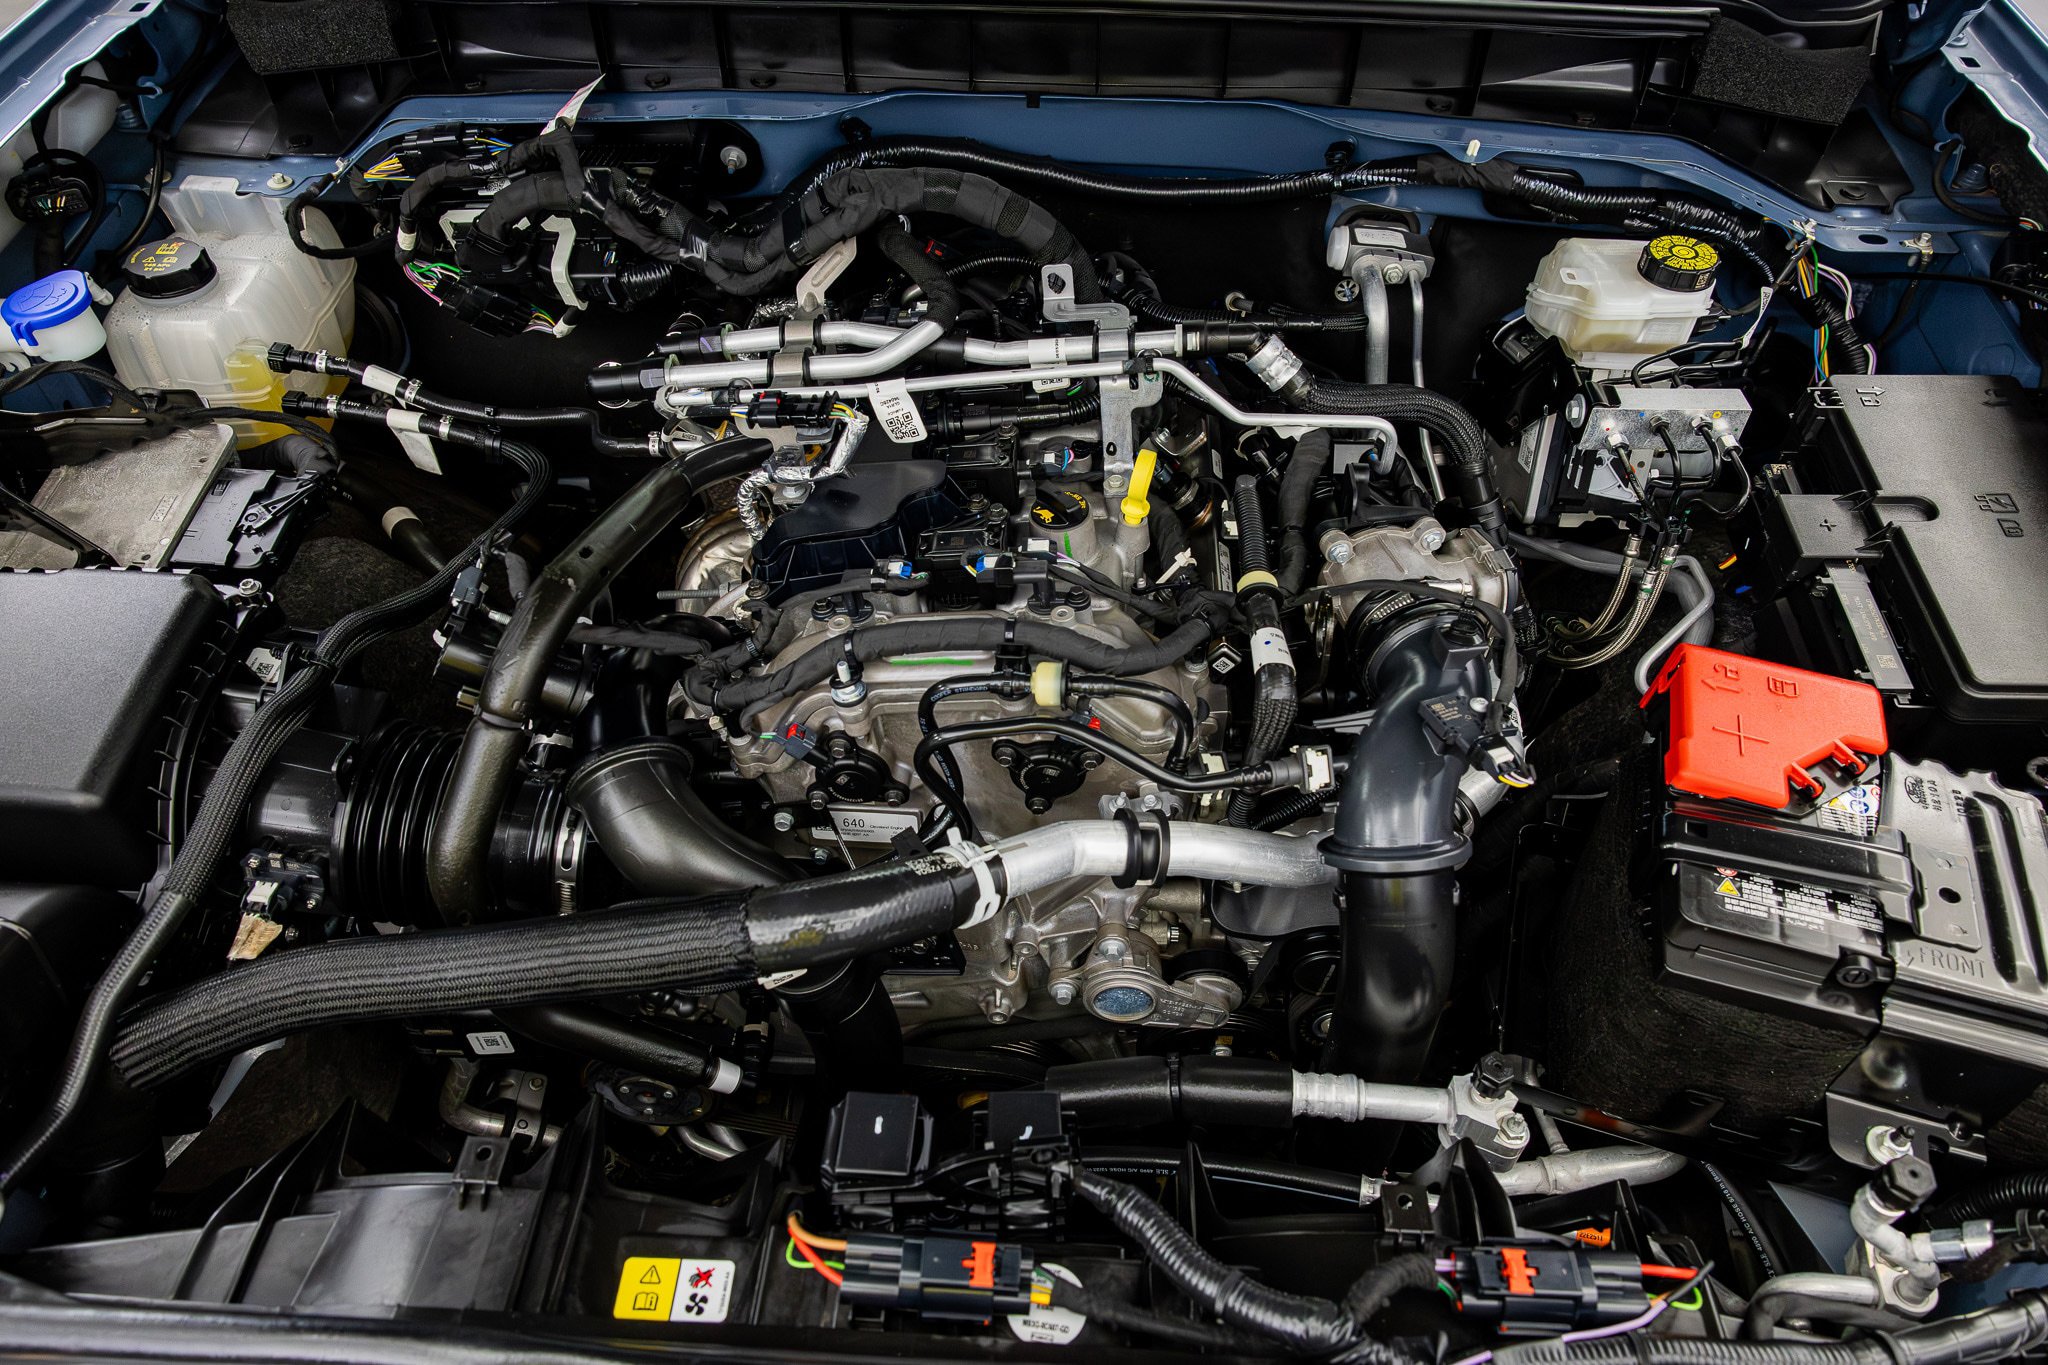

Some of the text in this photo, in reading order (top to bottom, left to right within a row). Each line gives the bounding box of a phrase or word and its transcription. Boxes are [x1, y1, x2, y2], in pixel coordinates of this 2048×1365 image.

[931, 689, 952, 702] COOPER
[843, 818, 865, 828] 640
[1920, 947, 1985, 978] FRONT
[1723, 1190, 1735, 1203] 5/16
[1732, 1203, 1747, 1223] HOSE
[1743, 1222, 1754, 1235] A/C
